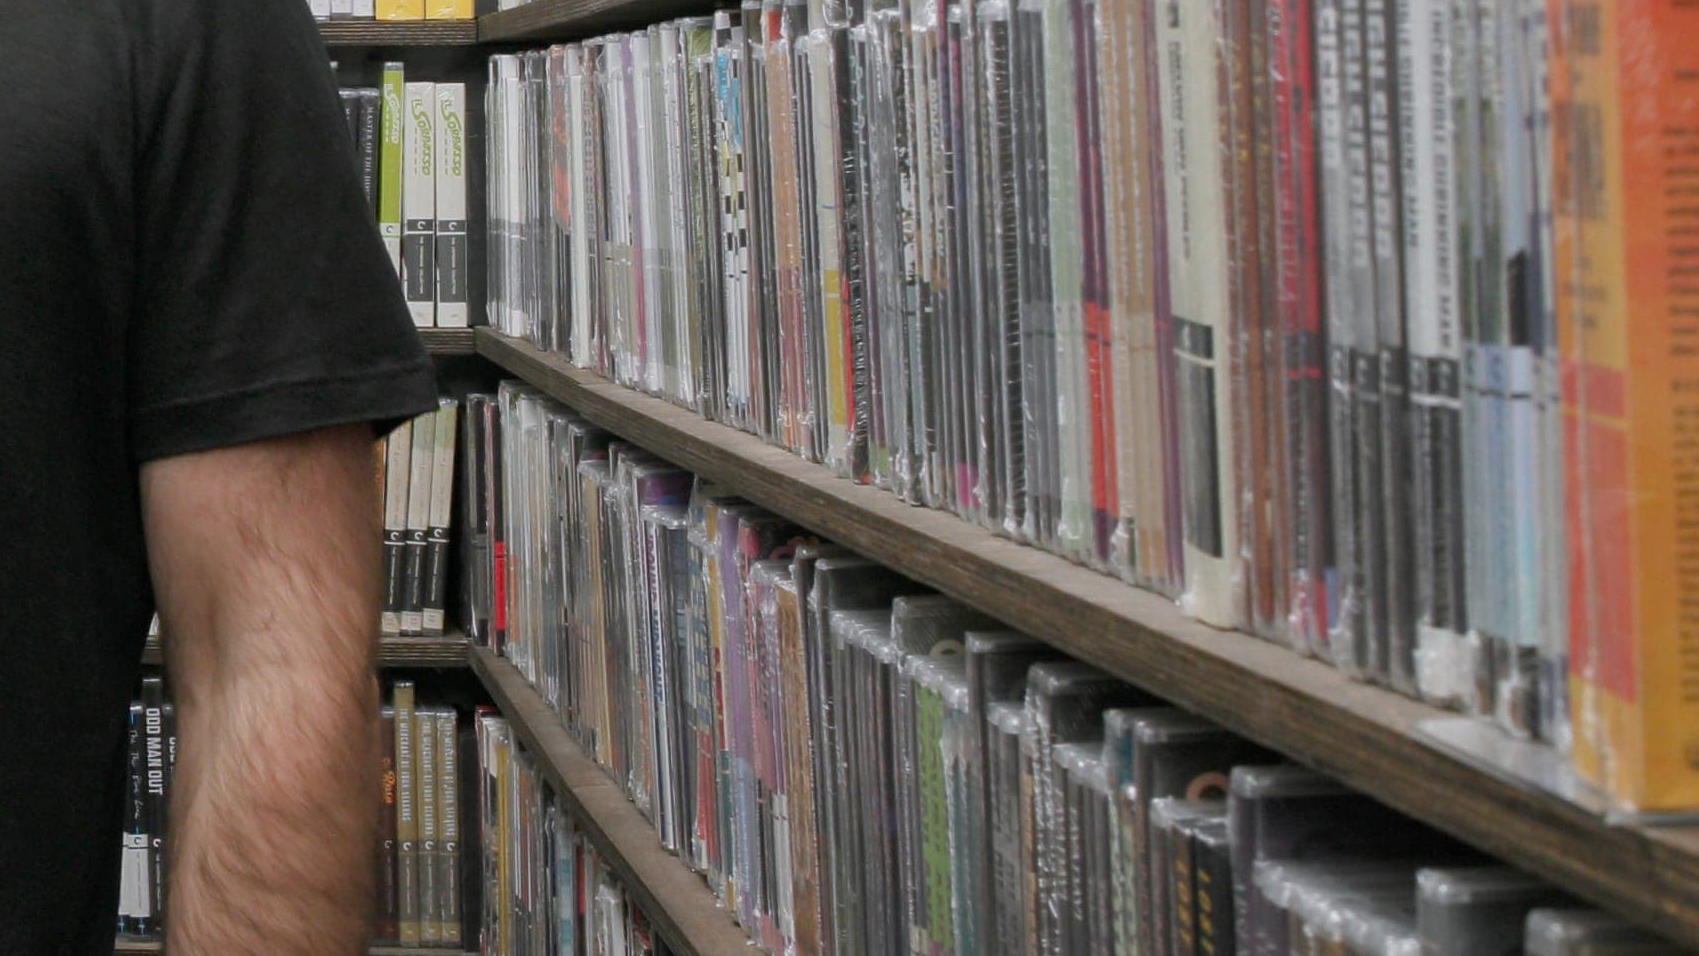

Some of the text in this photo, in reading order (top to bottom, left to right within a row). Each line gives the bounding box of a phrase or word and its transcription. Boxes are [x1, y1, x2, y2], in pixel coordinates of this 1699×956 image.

[146, 708, 162, 795] ODD MAN OUT
